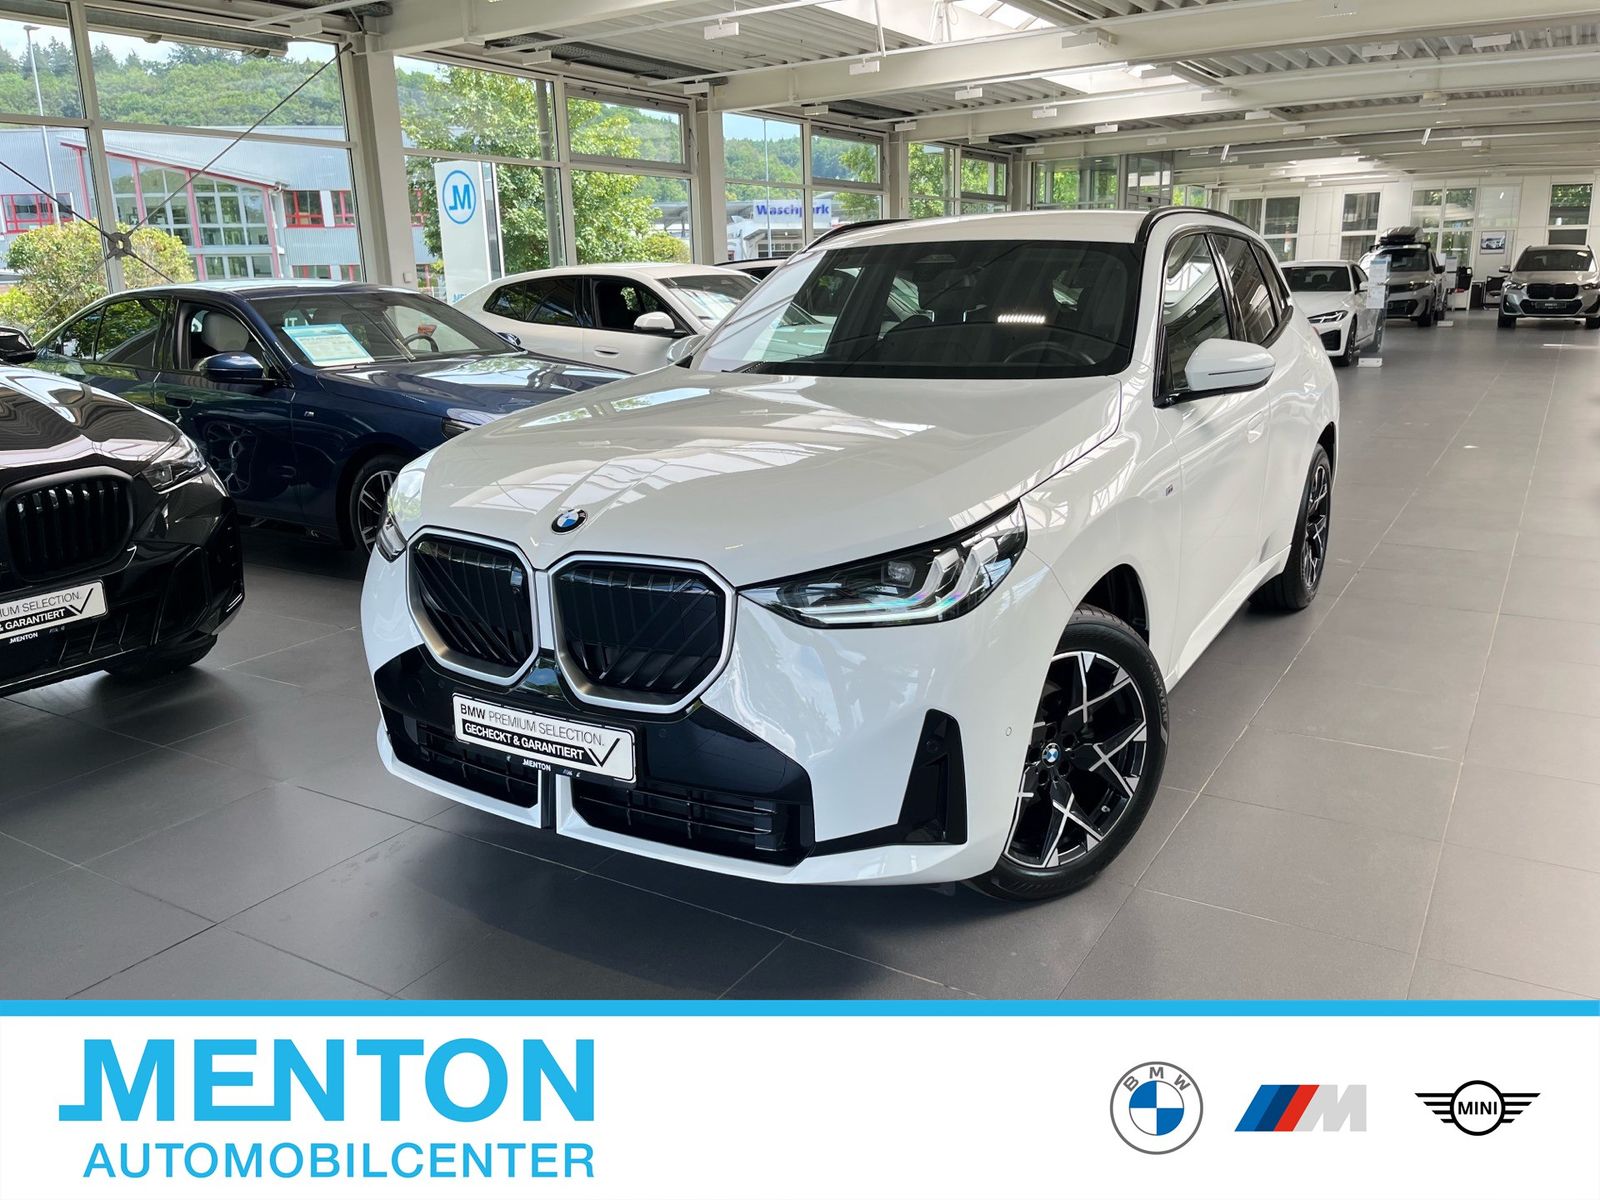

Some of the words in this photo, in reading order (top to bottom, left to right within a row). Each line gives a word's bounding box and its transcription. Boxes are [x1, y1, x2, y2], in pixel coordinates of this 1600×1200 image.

[756, 204, 829, 218] Waschrk
[5, 608, 66, 630] GARANTIERT
[9, 632, 39, 644] MENTON
[460, 703, 486, 720] BMW
[488, 710, 536, 732] PREMIUM
[538, 722, 605, 747] SELECTION.
[465, 722, 512, 745] GECHECKT
[513, 735, 521, 746] &
[521, 737, 584, 760] GARANTIERT
[522, 758, 552, 771] MENTON
